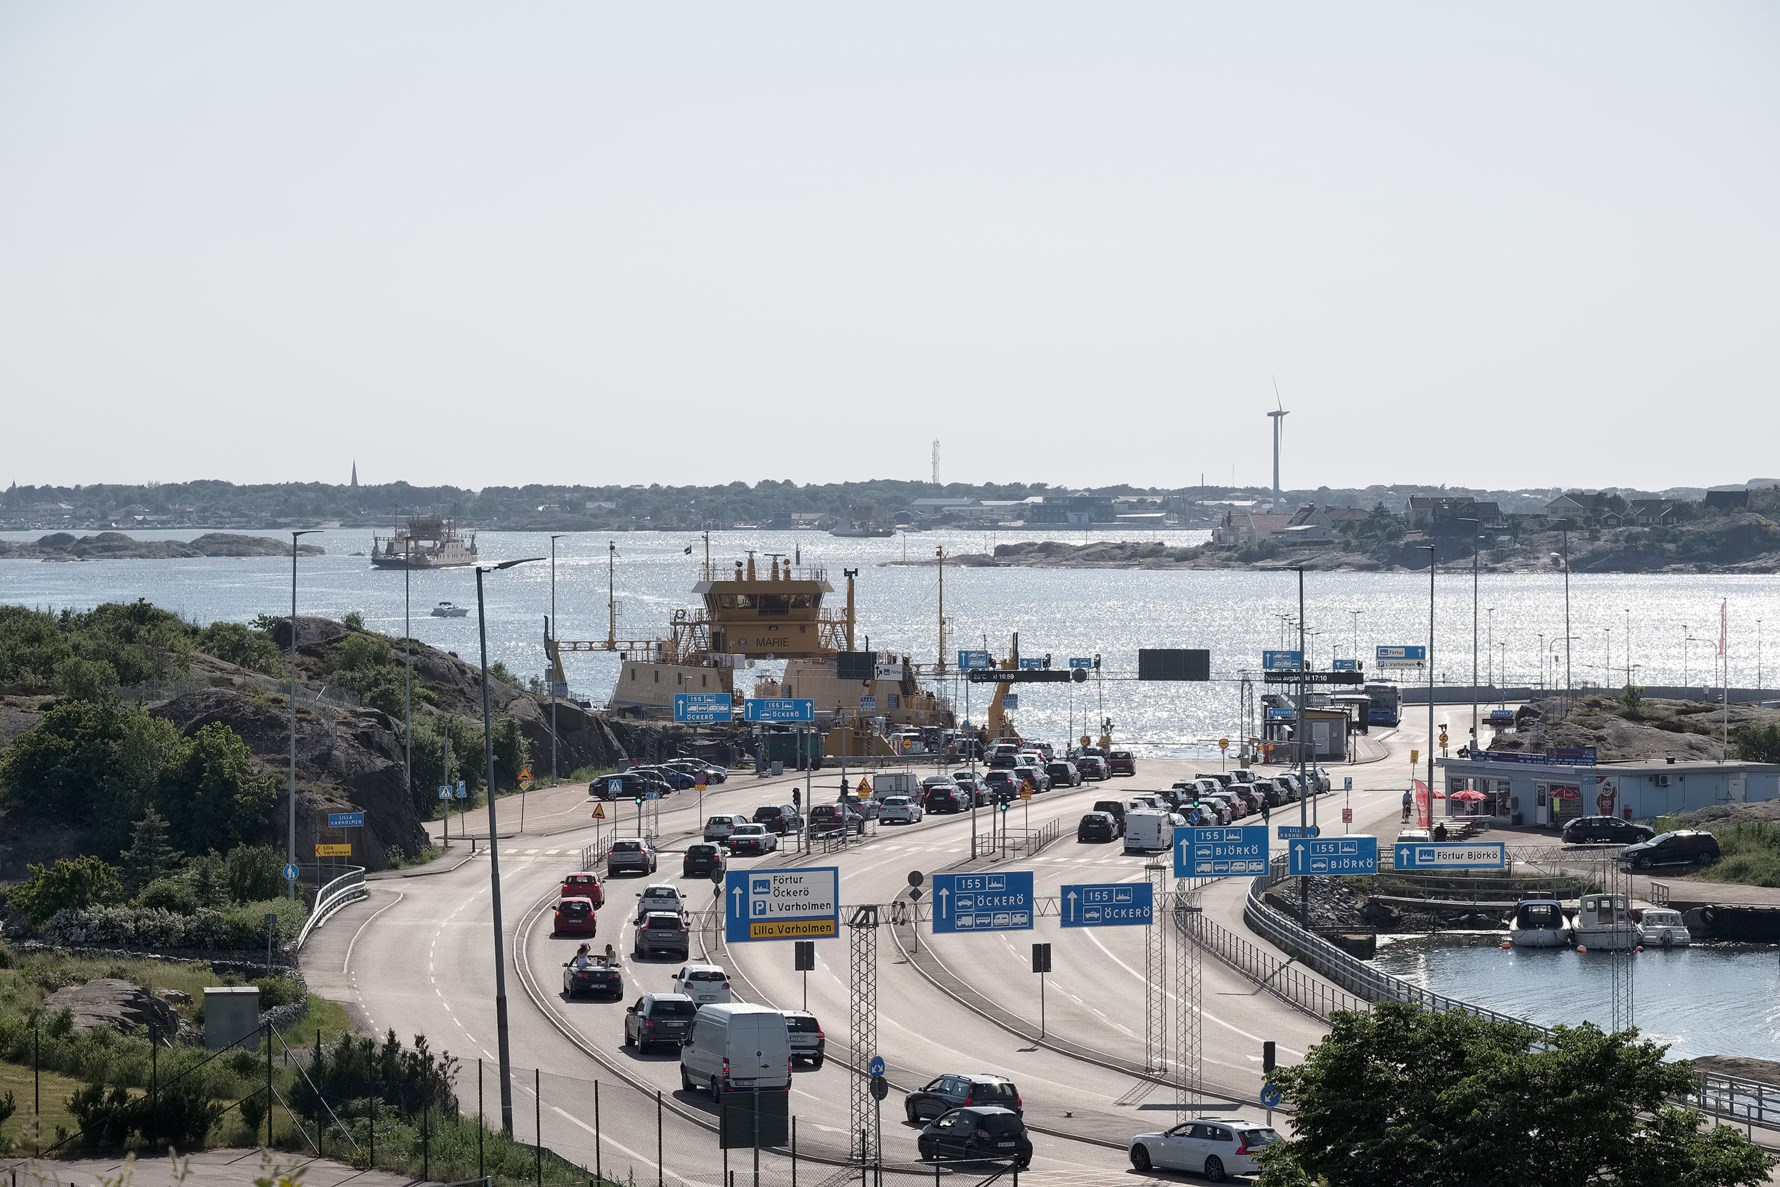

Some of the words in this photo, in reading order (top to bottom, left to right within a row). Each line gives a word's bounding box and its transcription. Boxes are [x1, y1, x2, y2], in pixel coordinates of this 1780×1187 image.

[756, 638, 790, 647] MARIE
[772, 710, 800, 718] ÖCKERÖ
[1201, 831, 1219, 840] 155
[1215, 844, 1259, 856] BJÖRKÖ
[1316, 844, 1334, 853] 155
[1437, 850, 1465, 860] Förtur
[1467, 850, 1498, 861] Björkö
[1331, 857, 1373, 869] BJÖRKÖ
[773, 874, 804, 885] Förtur
[961, 879, 981, 889] 155
[773, 886, 810, 898] Öckerö
[1089, 891, 1109, 901] 155
[977, 893, 1024, 907] ÖCKERÖ
[769, 903, 774, 912] L
[777, 901, 832, 912] Varholmen
[1104, 905, 1150, 919] ÖCKERÖ
[753, 924, 774, 936] Lilla
[777, 923, 832, 934] Varholmen
